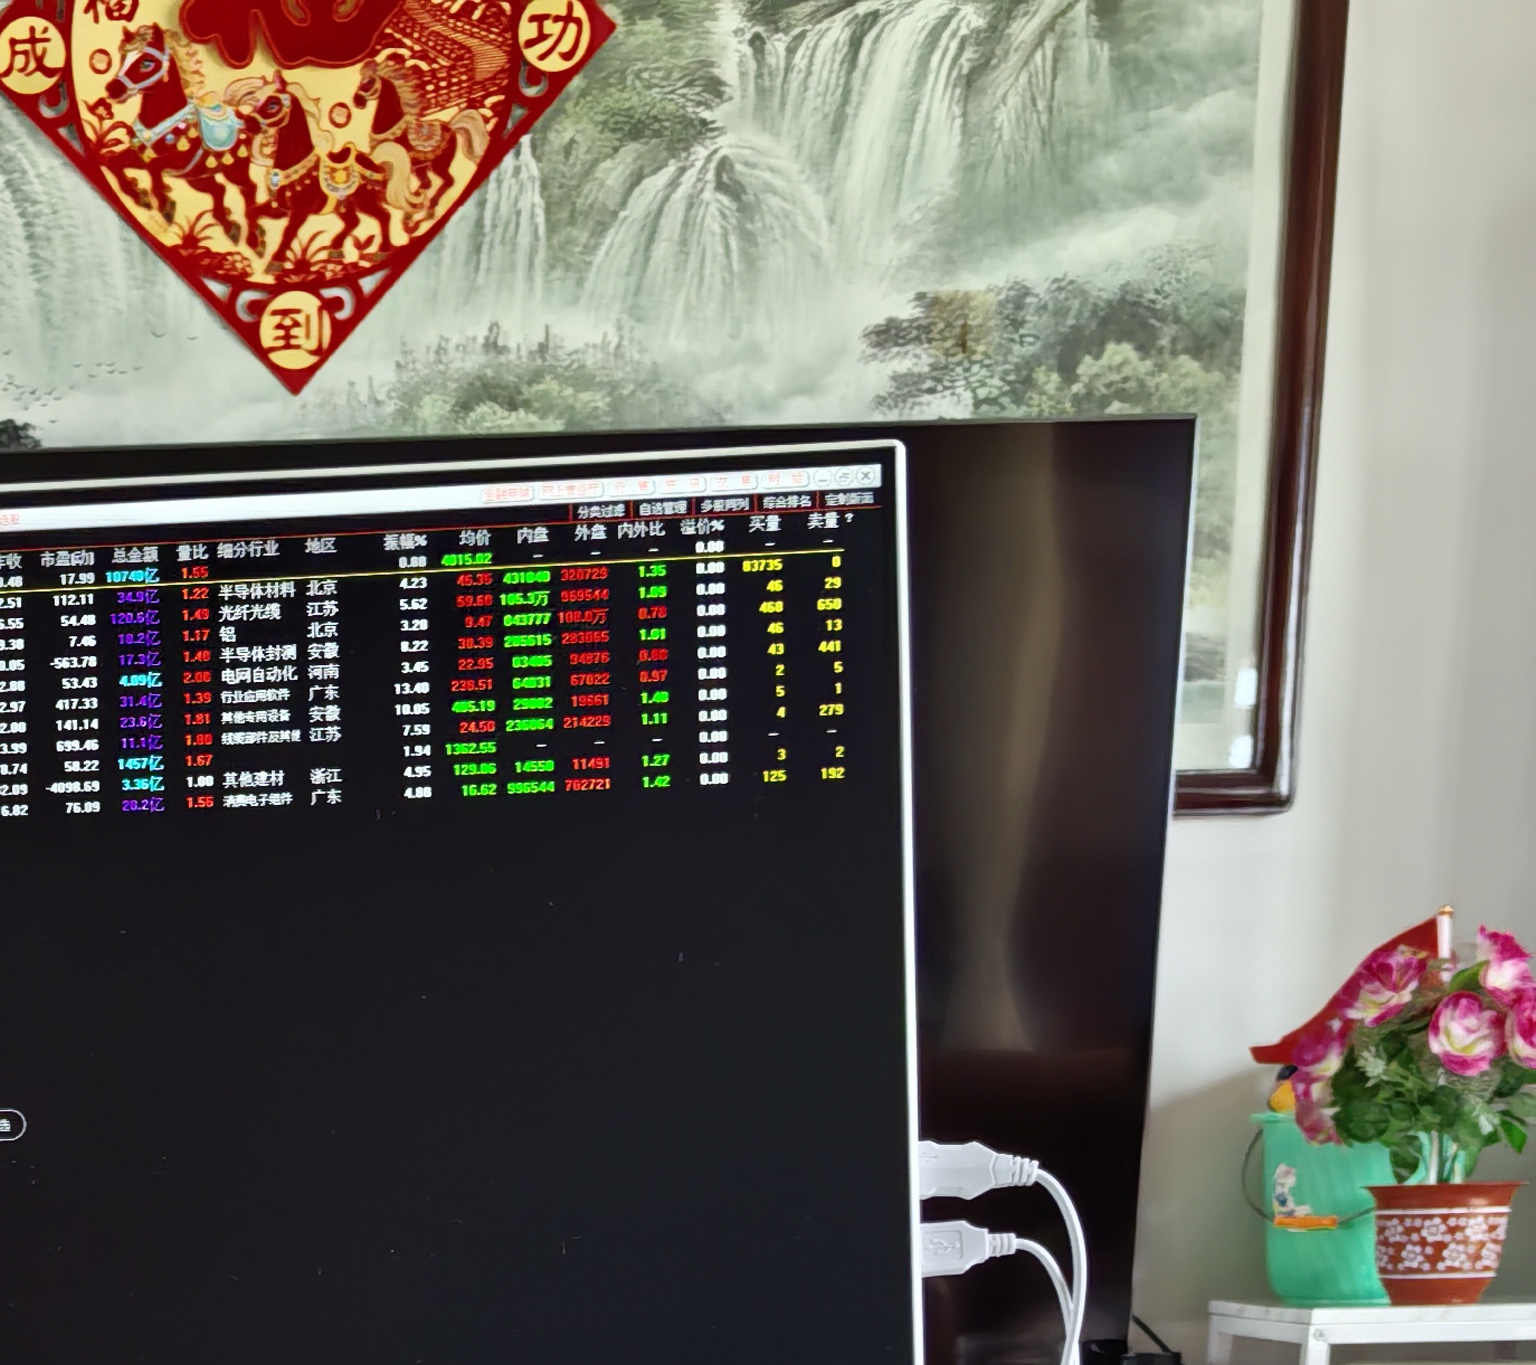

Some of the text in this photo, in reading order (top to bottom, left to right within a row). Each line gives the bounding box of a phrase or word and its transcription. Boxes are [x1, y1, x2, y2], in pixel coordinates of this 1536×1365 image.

[524, 2, 582, 62] 功
[2, 27, 61, 77] 成
[269, 307, 328, 358] 到
[112, 547, 159, 563] 总金额
[176, 545, 209, 561] 量比
[217, 541, 279, 558] 细分行业
[305, 538, 337, 554] 地区
[384, 534, 427, 550] 振幅%
[459, 530, 491, 546] 均价
[518, 528, 549, 543] 内盘
[575, 525, 607, 541] 外盘
[618, 522, 665, 538] 内外比
[680, 519, 724, 534] 溢价%
[749, 516, 781, 532] 买量
[807, 513, 839, 529] 卖量
[60, 572, 95, 585] 17.99
[53, 593, 94, 606] 112.11
[218, 582, 296, 600] 半导体材料
[306, 579, 337, 596] 北京
[219, 603, 281, 621] 光纤光缆
[306, 600, 339, 616] 江苏
[219, 626, 236, 642] 铝
[307, 621, 339, 638] 北京
[219, 644, 296, 662] 半导体封测
[307, 642, 339, 660] 安徽
[221, 666, 298, 684] 电网自动化
[308, 664, 339, 680] 河南
[308, 684, 339, 701] 广东
[56, 719, 98, 730] 141.14
[309, 705, 341, 722] 安徽
[309, 726, 341, 742] 江苏
[118, 755, 164, 771] 1457亿
[186, 754, 213, 766] 1.67
[223, 770, 285, 788] 其他建材
[310, 768, 343, 784] 浙江
[311, 788, 342, 805] 广东
[763, 769, 787, 783] 125
[821, 767, 845, 780] 192
